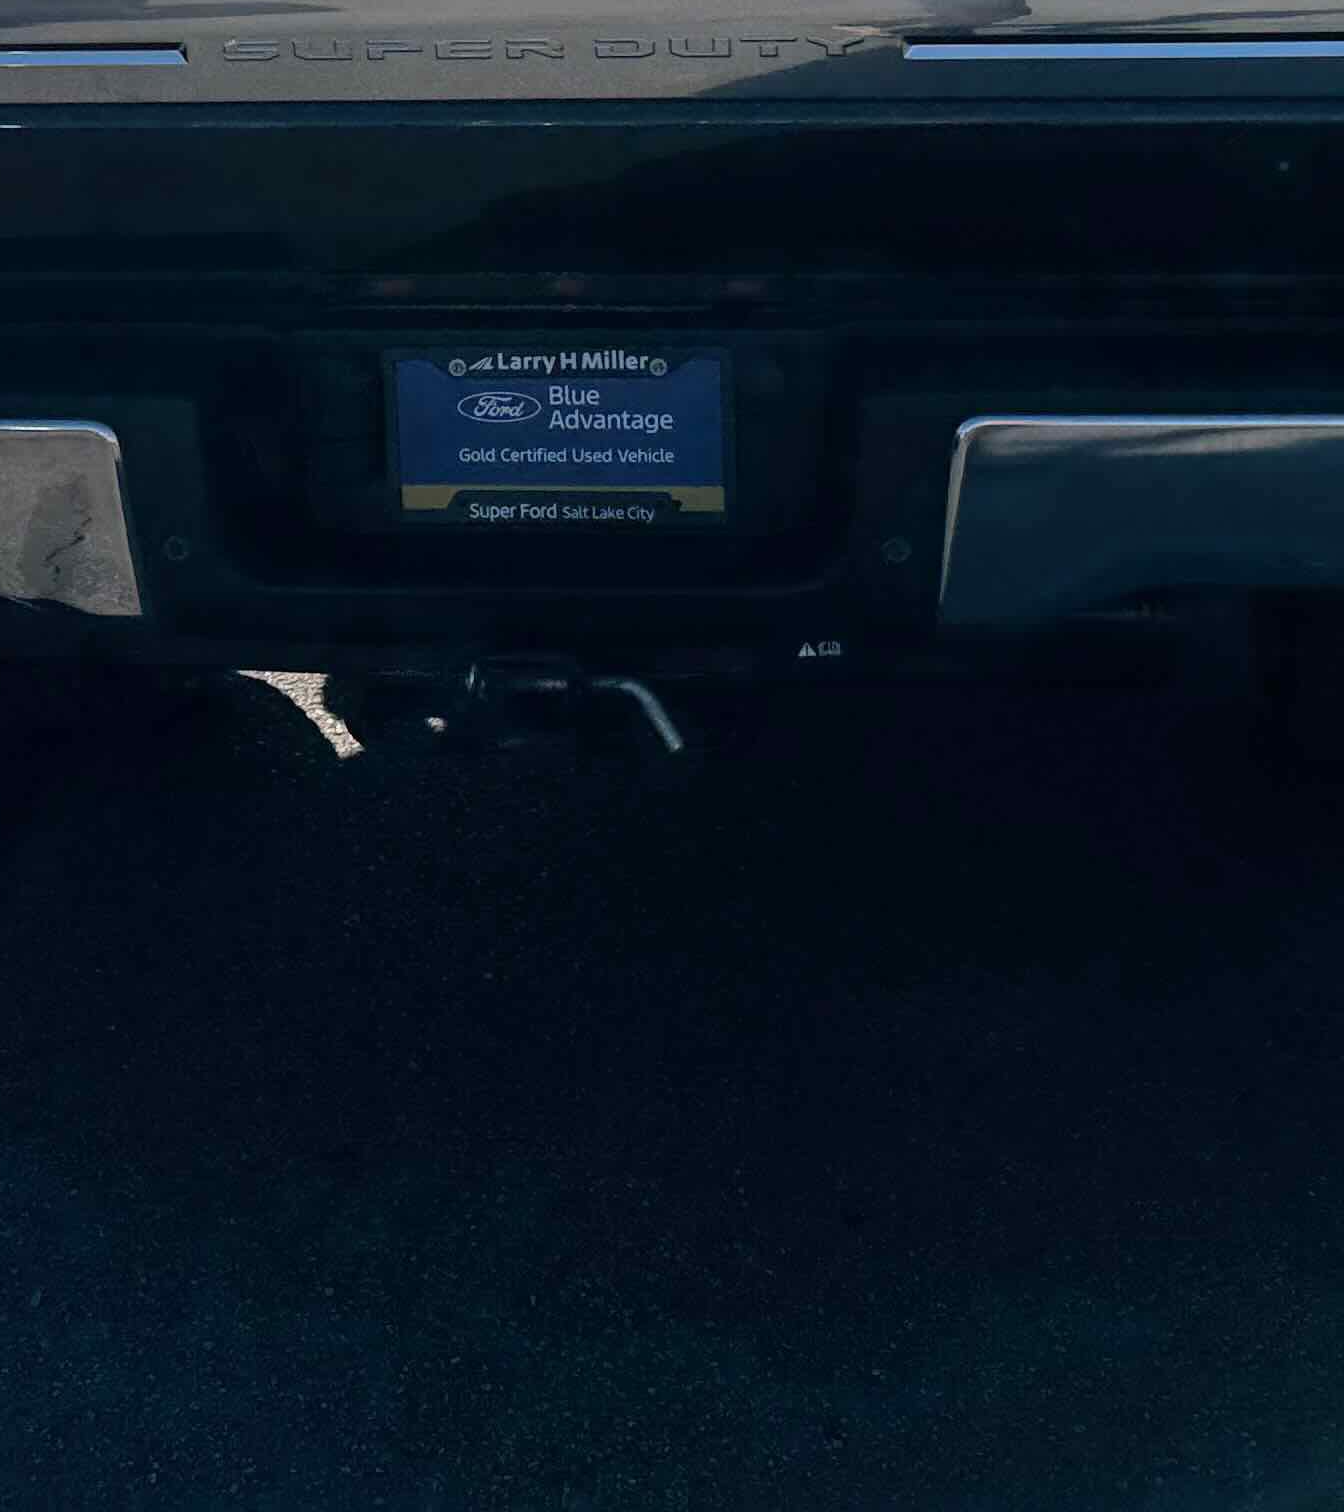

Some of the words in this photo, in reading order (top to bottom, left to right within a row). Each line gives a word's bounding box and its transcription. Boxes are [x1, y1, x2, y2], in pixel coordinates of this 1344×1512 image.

[222, 36, 565, 63] SUPER
[594, 33, 867, 60] DUTY
[497, 352, 556, 374] Larry
[560, 351, 577, 371] H
[582, 349, 649, 371] Miller
[474, 394, 526, 418] Ford
[549, 385, 600, 406] Blue
[548, 408, 674, 434] Advantage
[458, 446, 496, 463] Gold
[500, 446, 567, 463] Certified
[572, 447, 613, 463] Used
[617, 447, 675, 463] Vehicle
[469, 502, 515, 522] Super
[520, 502, 557, 520] Ford
[562, 504, 588, 520] Salt
[592, 504, 624, 520] Lake
[627, 505, 655, 523] City
